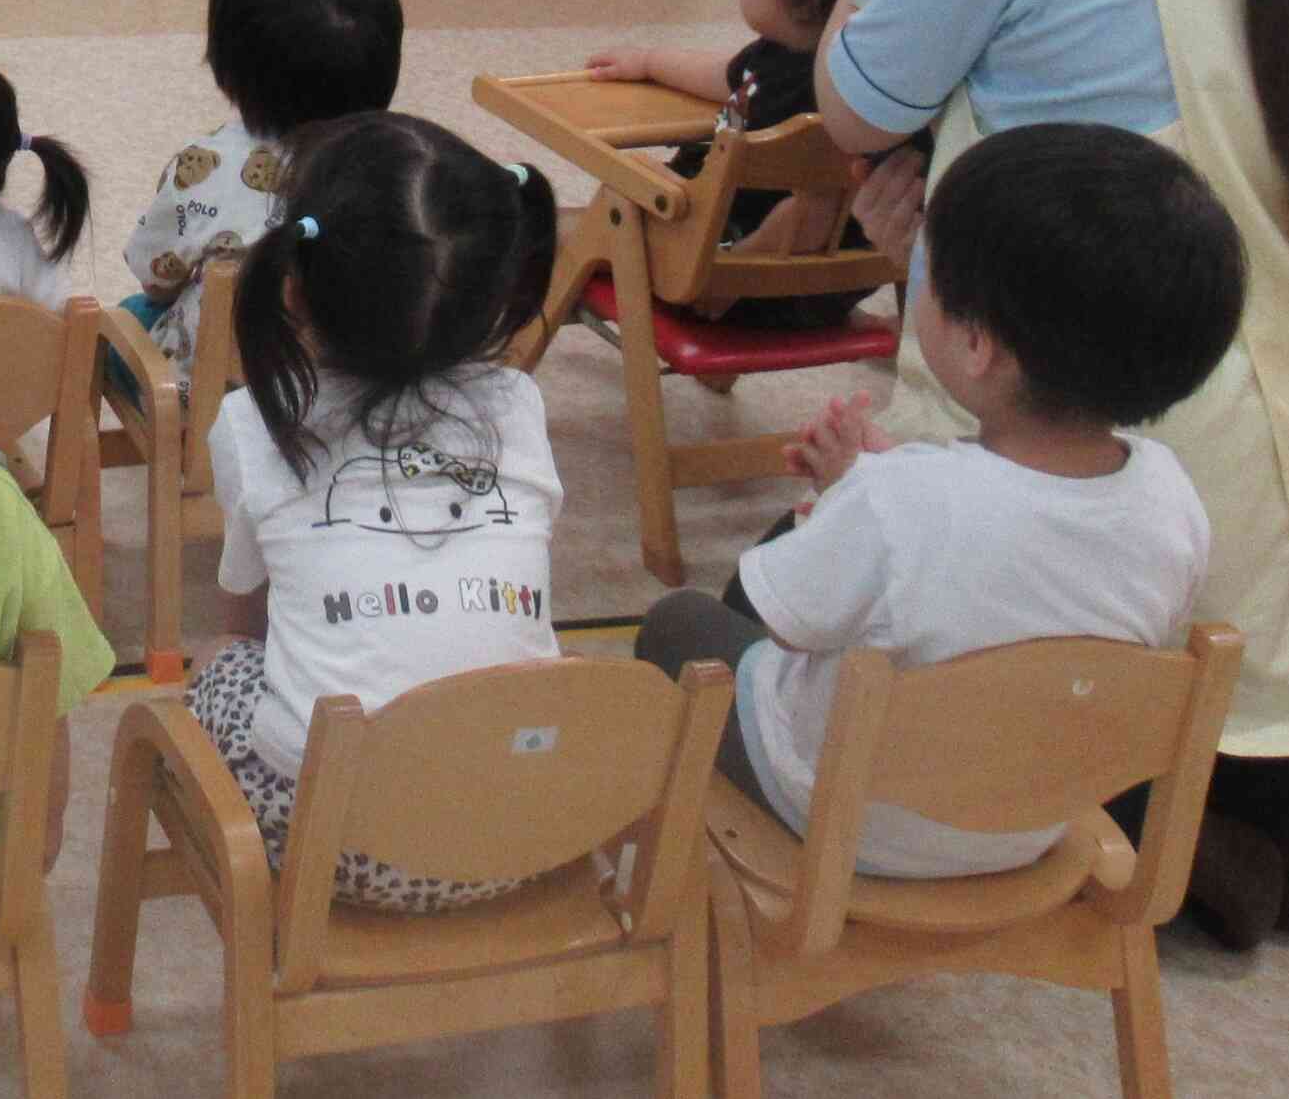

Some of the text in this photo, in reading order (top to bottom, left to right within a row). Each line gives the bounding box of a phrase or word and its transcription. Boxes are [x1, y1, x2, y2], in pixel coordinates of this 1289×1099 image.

[187, 200, 218, 218] POLO
[323, 577, 541, 624] Hello Kitty
